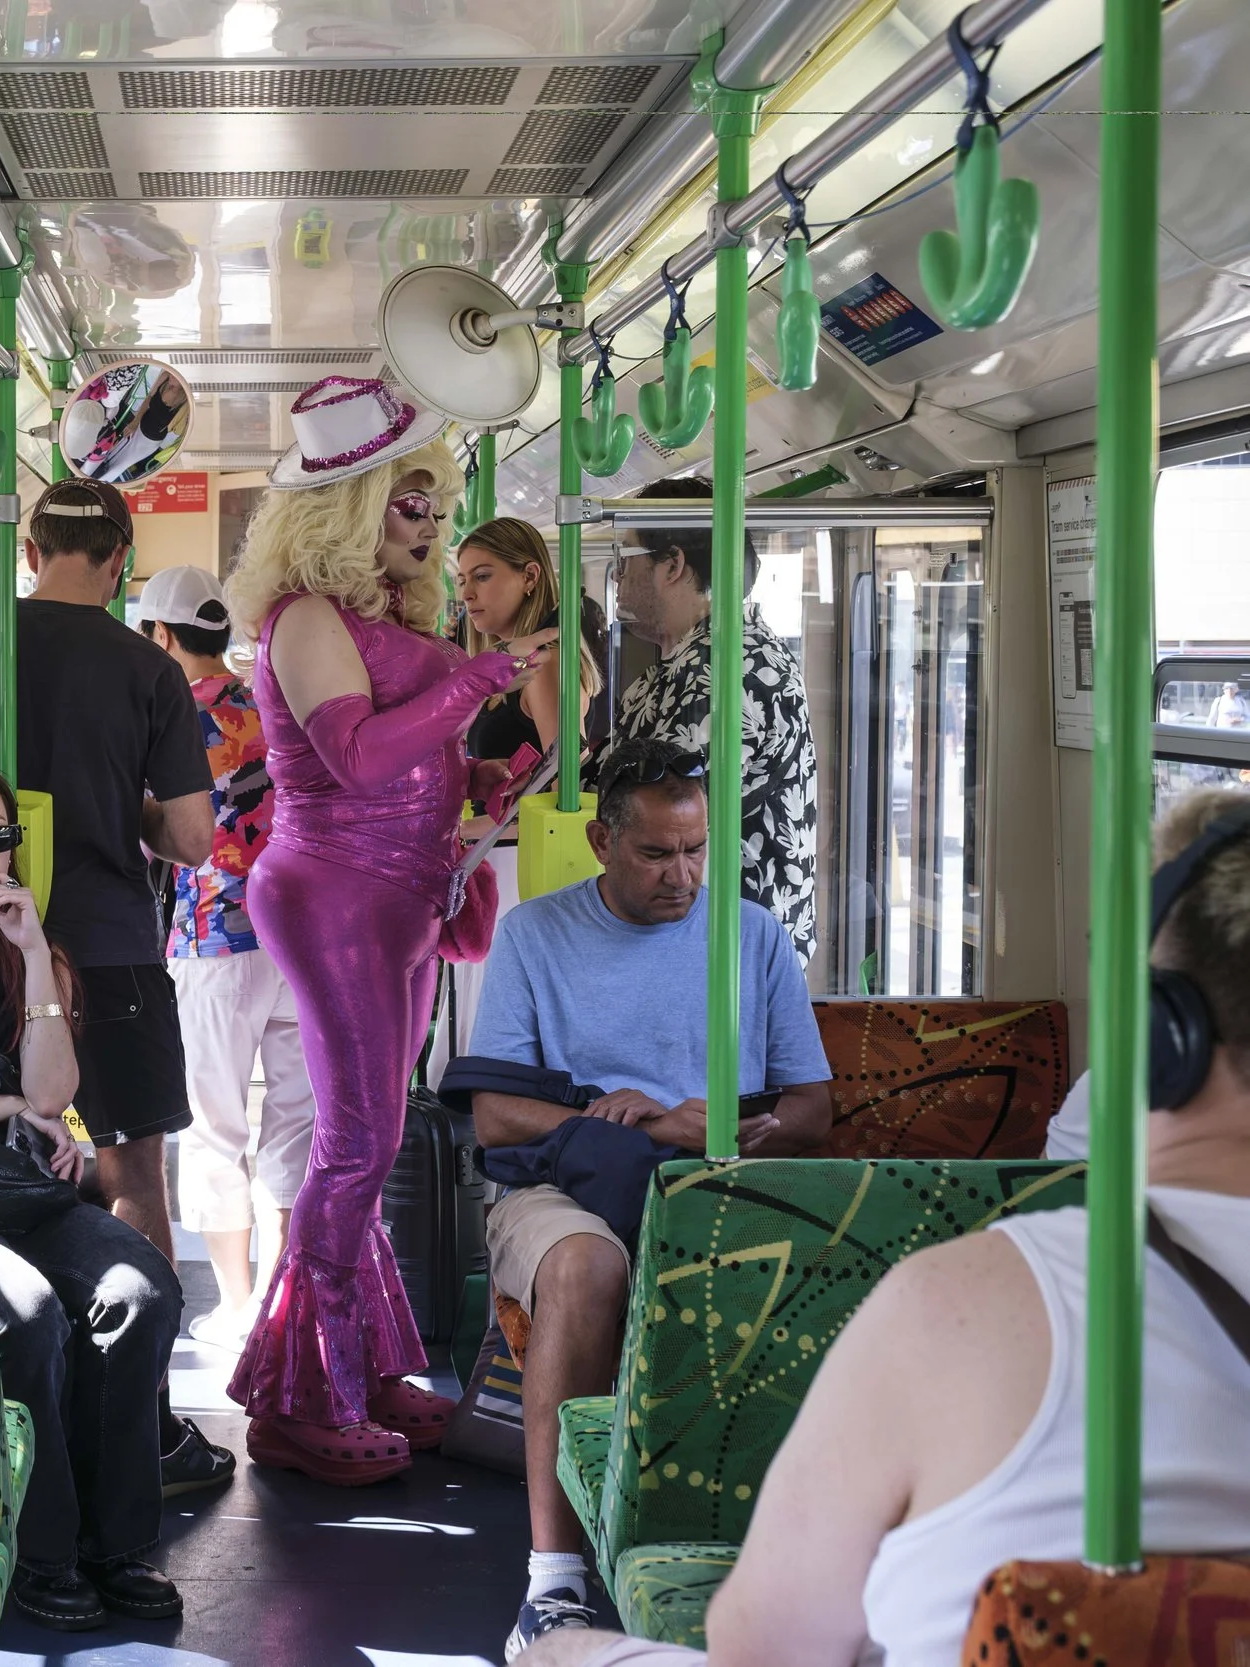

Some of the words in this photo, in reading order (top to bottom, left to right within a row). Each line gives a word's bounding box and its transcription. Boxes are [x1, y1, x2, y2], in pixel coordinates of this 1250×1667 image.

[1051, 520, 1063, 533] Tram
[1064, 517, 1079, 532] service
[63, 1115, 84, 1128] tep
